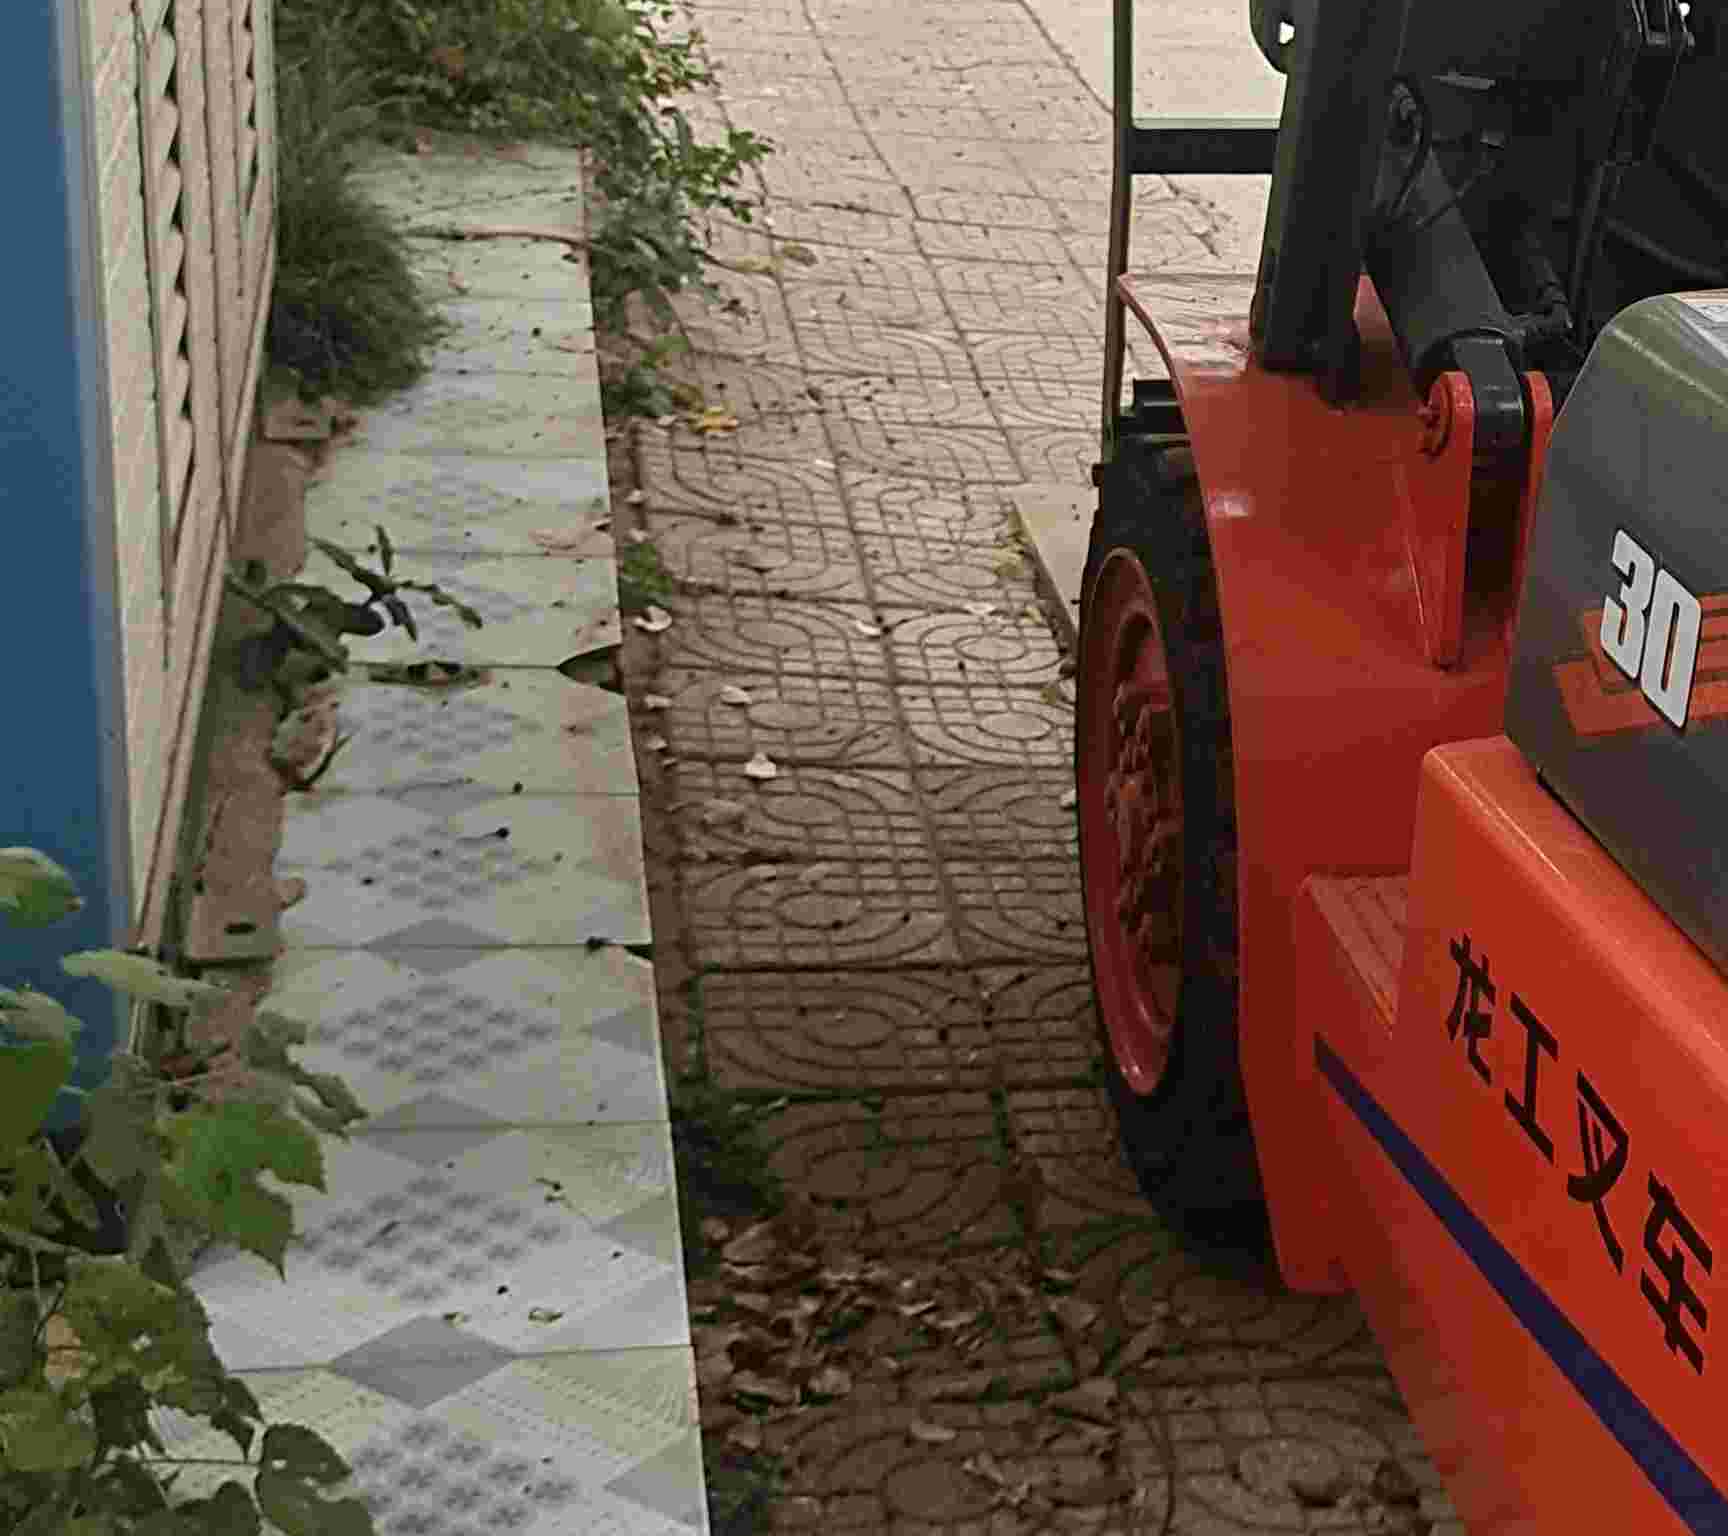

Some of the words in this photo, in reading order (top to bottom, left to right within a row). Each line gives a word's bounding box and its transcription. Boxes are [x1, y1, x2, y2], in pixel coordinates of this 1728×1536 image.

[1600, 528, 1702, 729] 30
[1446, 932, 1712, 1376] 龙工叉车
